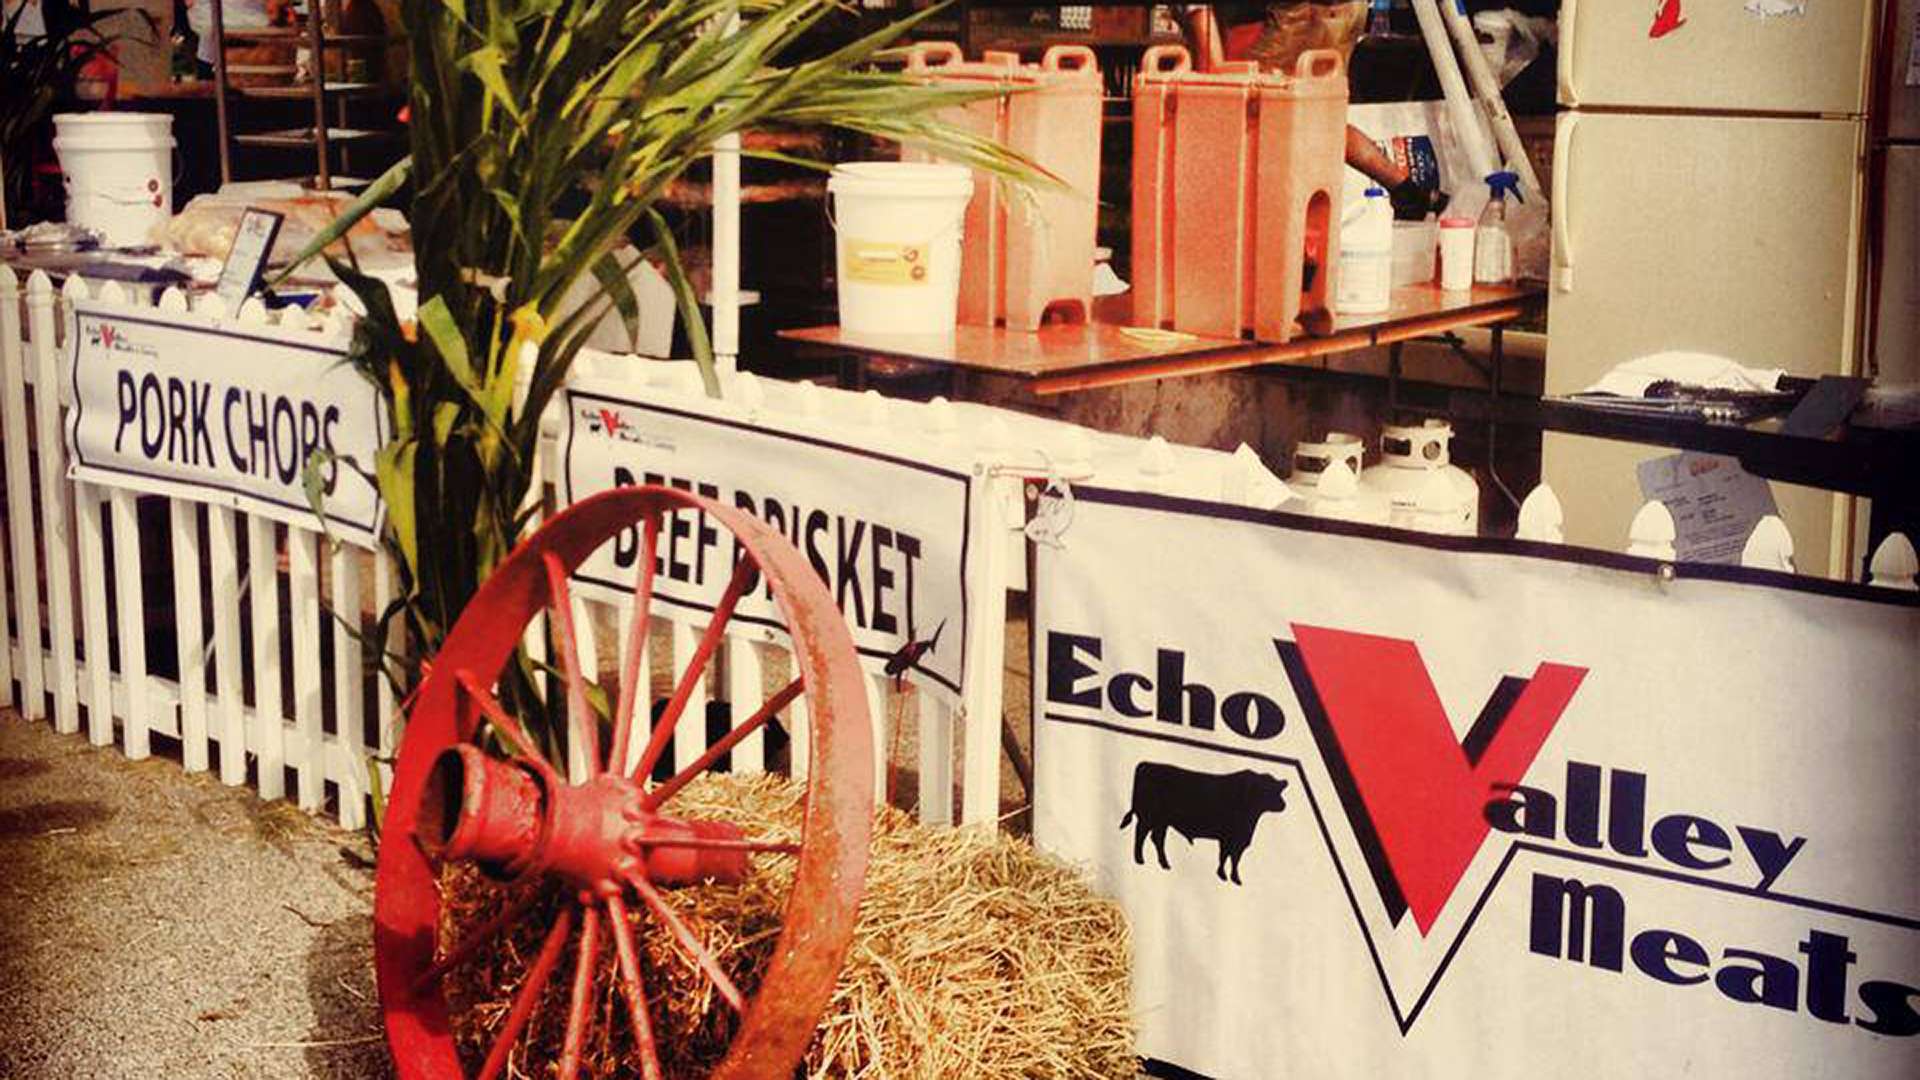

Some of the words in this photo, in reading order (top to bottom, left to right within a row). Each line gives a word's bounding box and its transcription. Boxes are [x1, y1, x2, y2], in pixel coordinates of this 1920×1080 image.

[114, 369, 216, 469] PORK
[223, 386, 340, 497] CHOPS
[1047, 630, 1286, 740] Echo
[1275, 623, 1808, 937] Valley
[1529, 872, 1920, 1037] Meats
